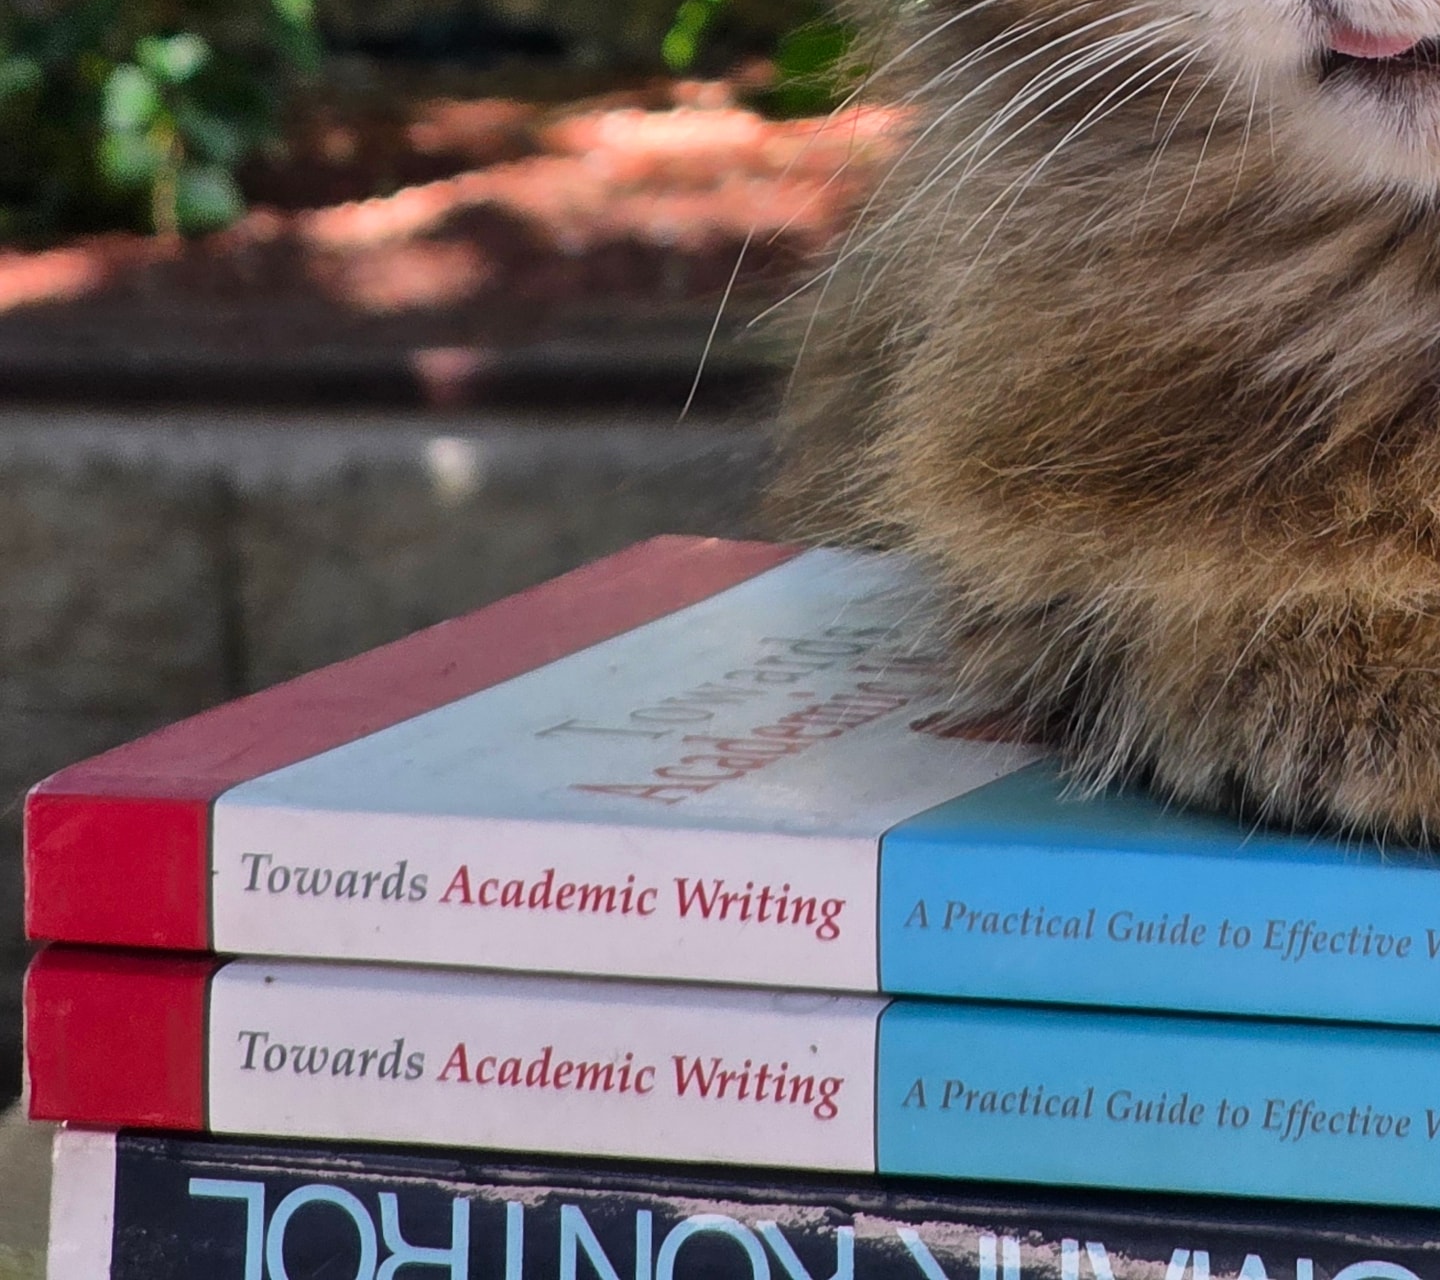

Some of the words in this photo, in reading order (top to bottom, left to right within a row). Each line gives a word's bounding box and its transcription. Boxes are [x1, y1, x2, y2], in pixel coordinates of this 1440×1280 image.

[240, 852, 429, 902] Towards
[439, 864, 659, 916] Academic
[672, 875, 847, 941] Writing
[903, 898, 929, 930] A
[942, 900, 1096, 940] Practical
[1107, 910, 1207, 947] Guide
[1218, 918, 1252, 950] to
[1263, 919, 1412, 962] Effective
[237, 1029, 426, 1081] Towards
[436, 1042, 657, 1094] Academic
[671, 1053, 845, 1120] Writing
[901, 1077, 928, 1109] A
[940, 1079, 1094, 1120] Practical
[1106, 1089, 1206, 1127] Guide
[1216, 1098, 1251, 1130] to
[1262, 1098, 1412, 1141] Effective
